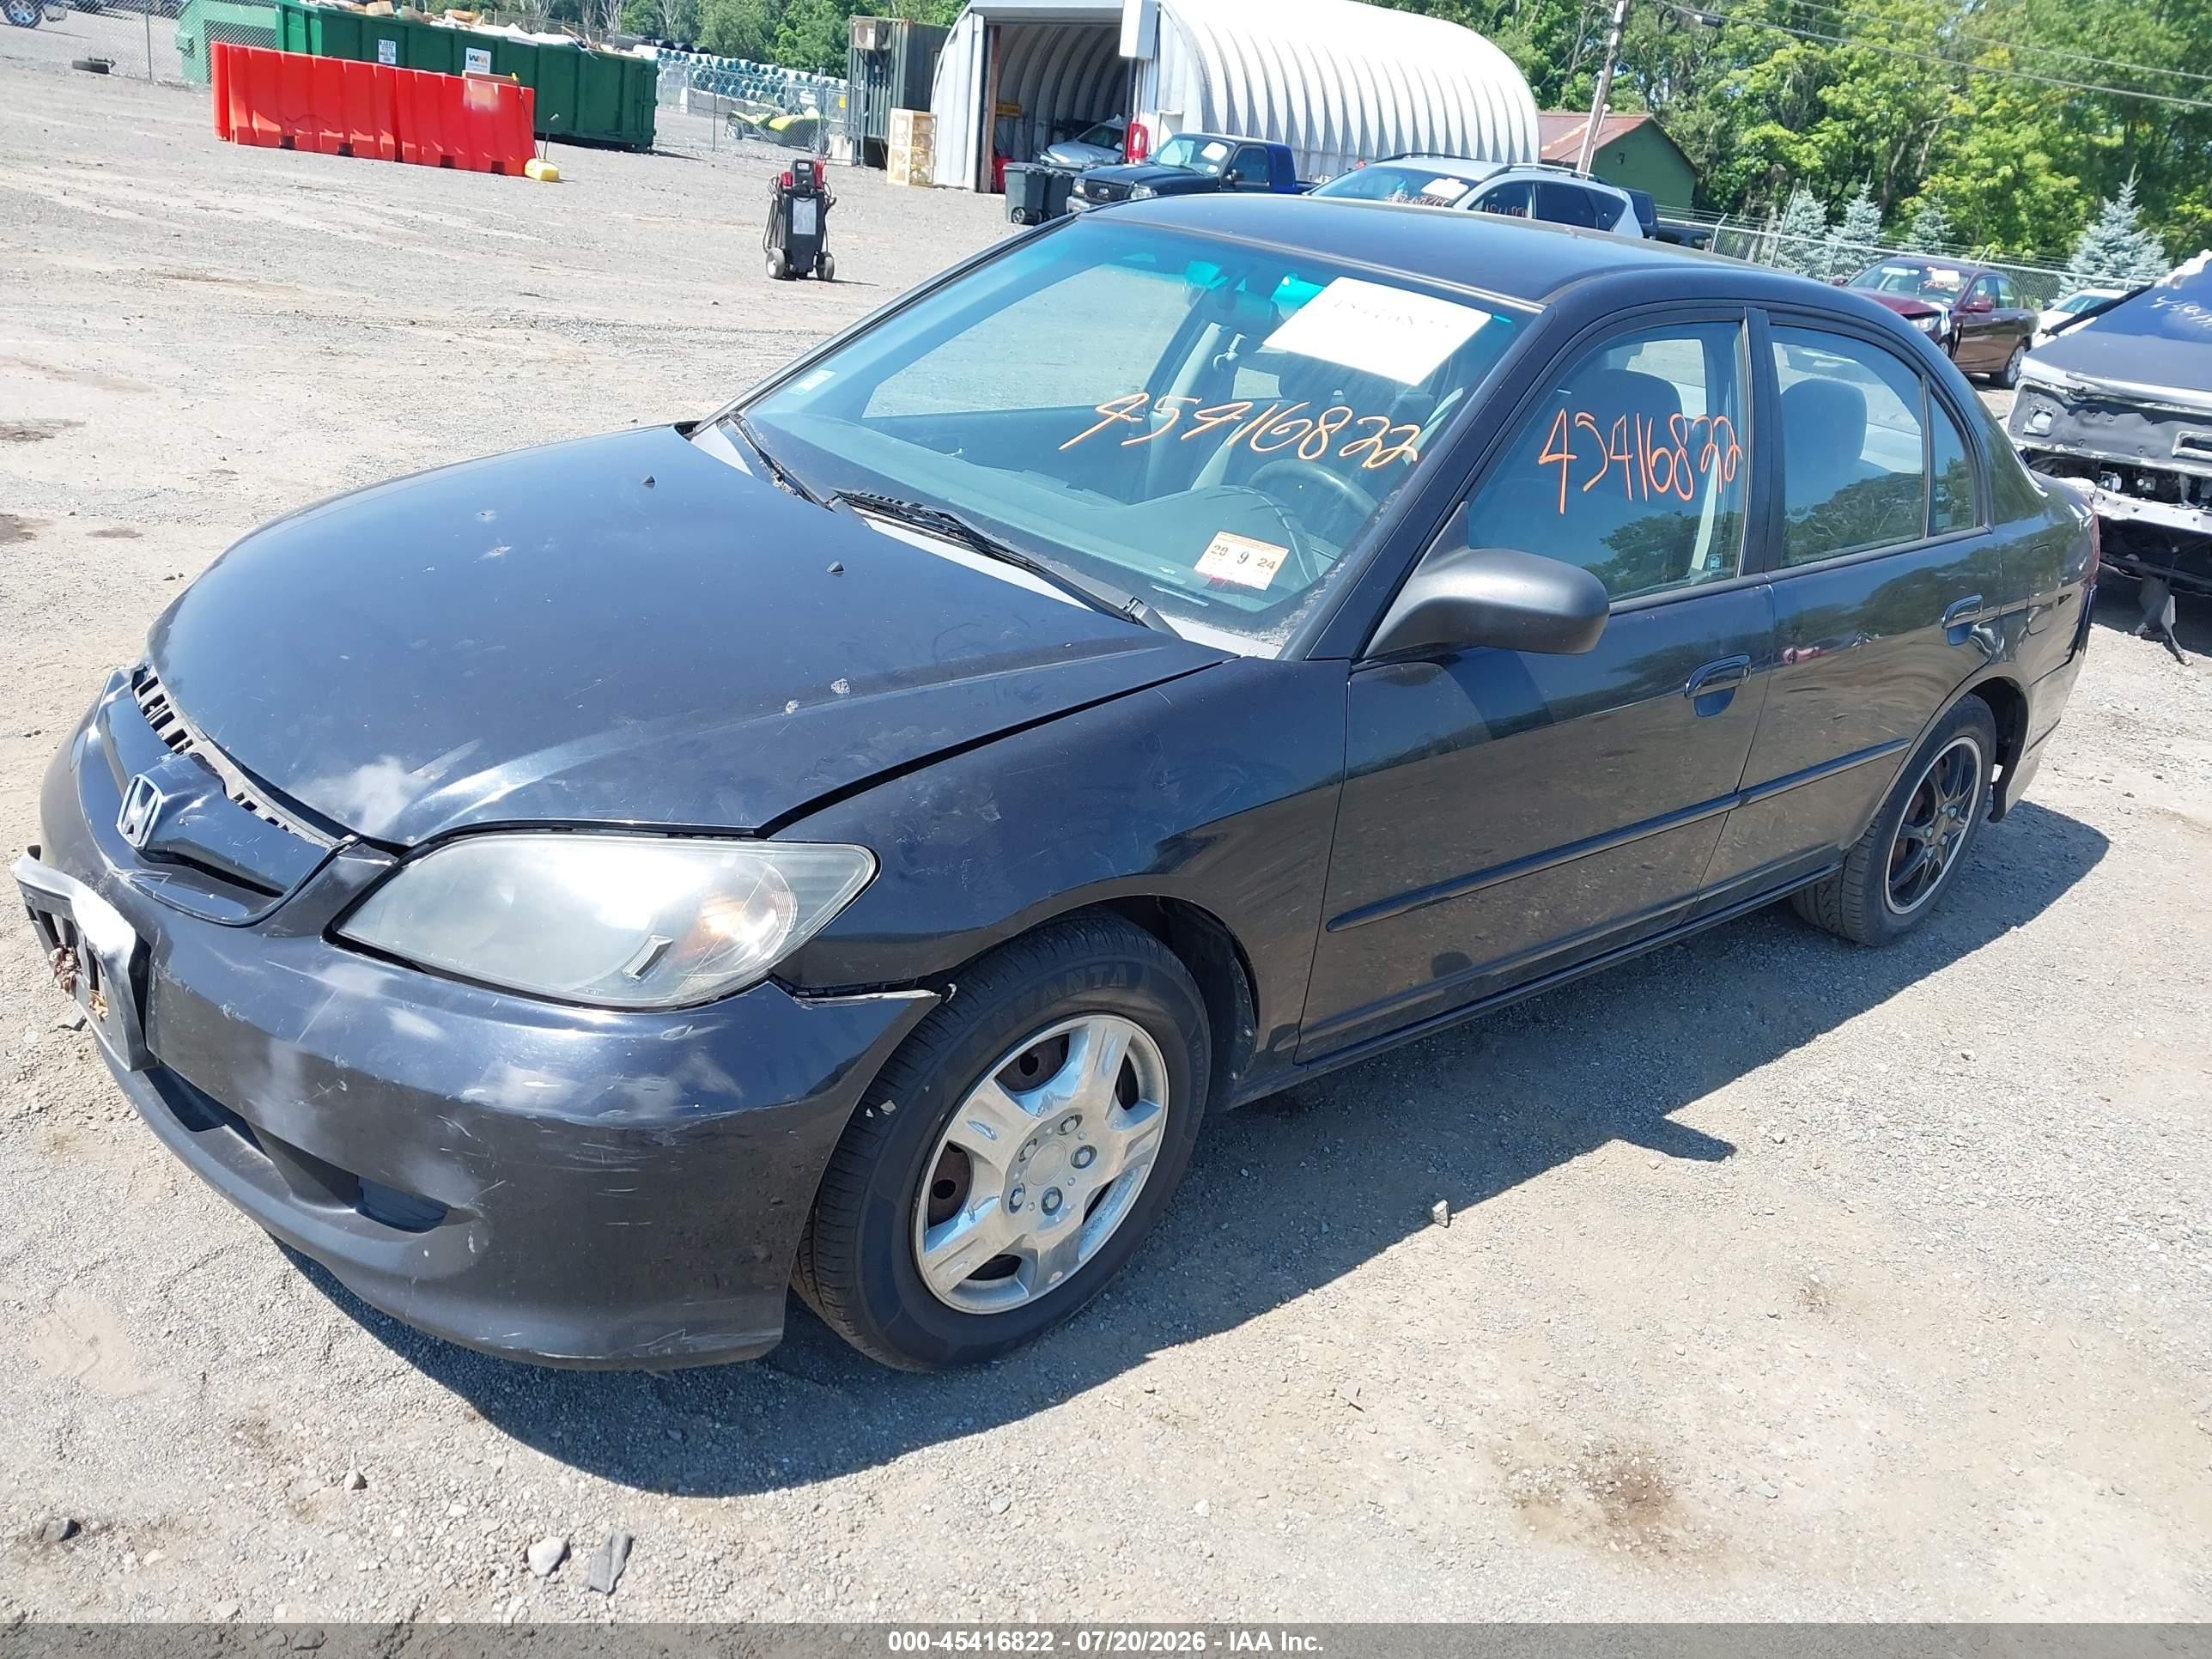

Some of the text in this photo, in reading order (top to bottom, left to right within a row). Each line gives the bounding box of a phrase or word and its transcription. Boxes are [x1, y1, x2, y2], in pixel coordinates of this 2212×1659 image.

[1058, 392, 1422, 469] 45416822
[1538, 407, 1744, 515] 45416822
[1237, 550, 1250, 564] 9
[1256, 557, 1277, 569] 24
